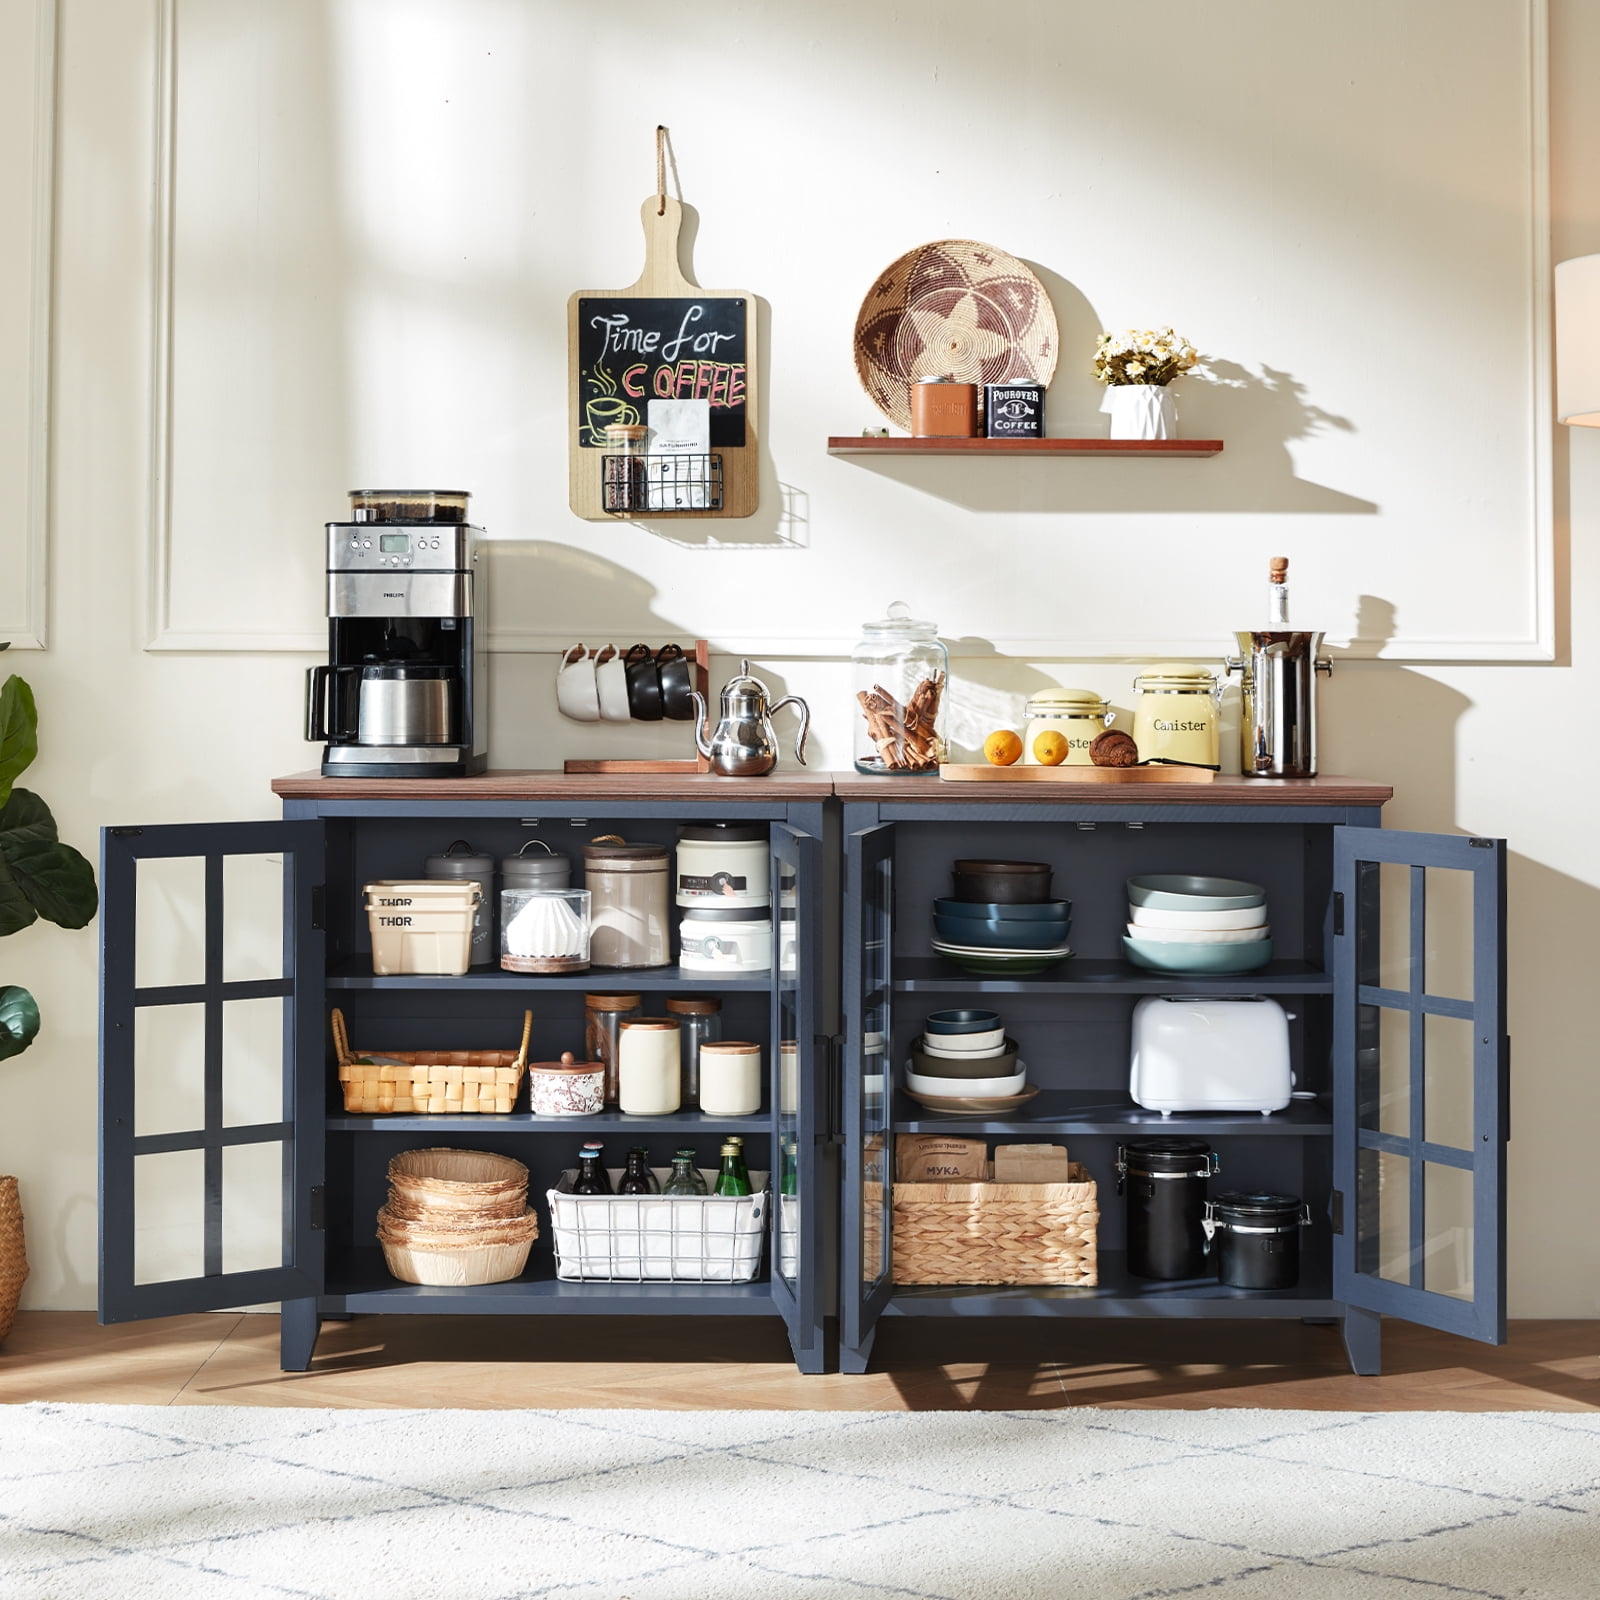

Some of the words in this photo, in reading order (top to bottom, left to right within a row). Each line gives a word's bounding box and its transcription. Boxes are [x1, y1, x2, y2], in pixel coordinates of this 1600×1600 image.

[591, 314, 661, 364] Time
[662, 305, 736, 362] for
[992, 390, 1039, 402] POUROVER
[994, 420, 1038, 430] COFFEE
[1153, 718, 1207, 731] Canister
[378, 898, 413, 906] THOR
[378, 916, 413, 927] THOR
[926, 1166, 961, 1175] МУКА
